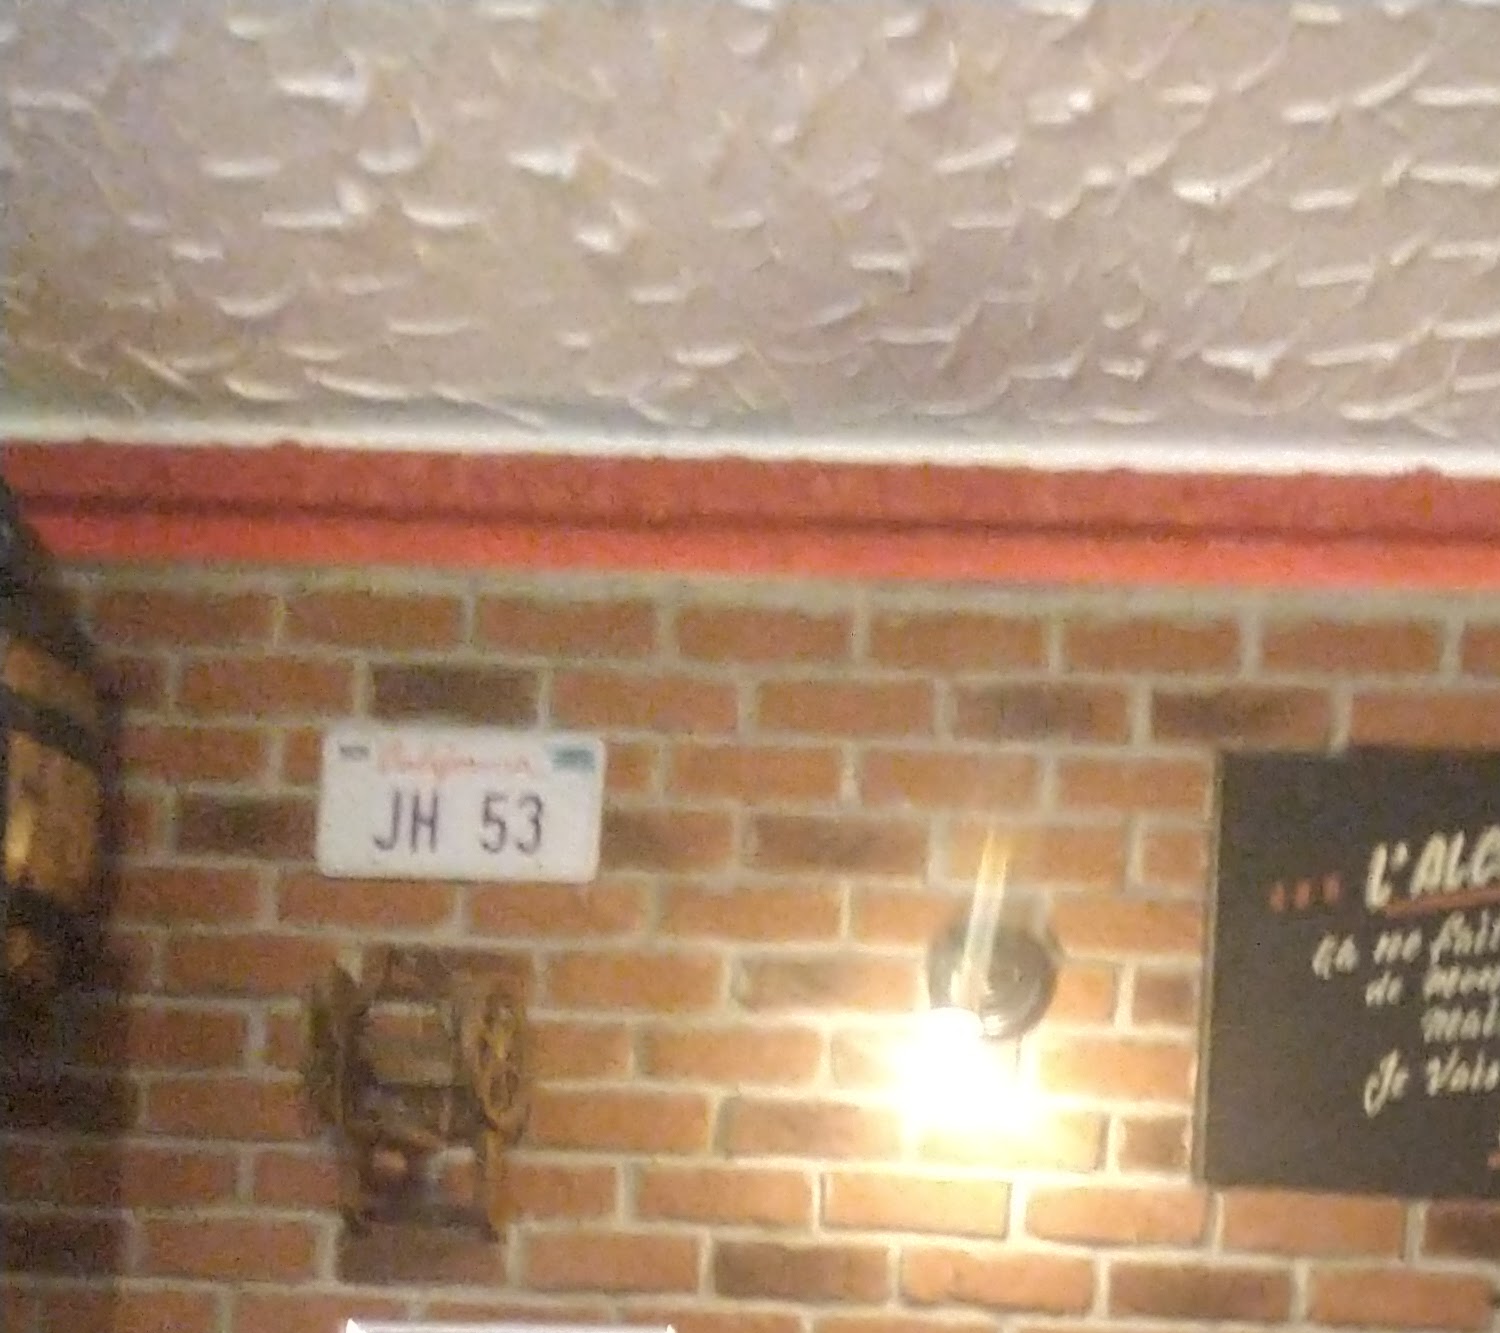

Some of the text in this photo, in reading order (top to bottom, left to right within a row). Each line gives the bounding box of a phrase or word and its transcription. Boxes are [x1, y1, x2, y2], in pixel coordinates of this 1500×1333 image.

[372, 788, 543, 853] JH 53
[1373, 929, 1422, 964] ne
[1365, 969, 1403, 1005] de
[1364, 1049, 1410, 1118] Je
